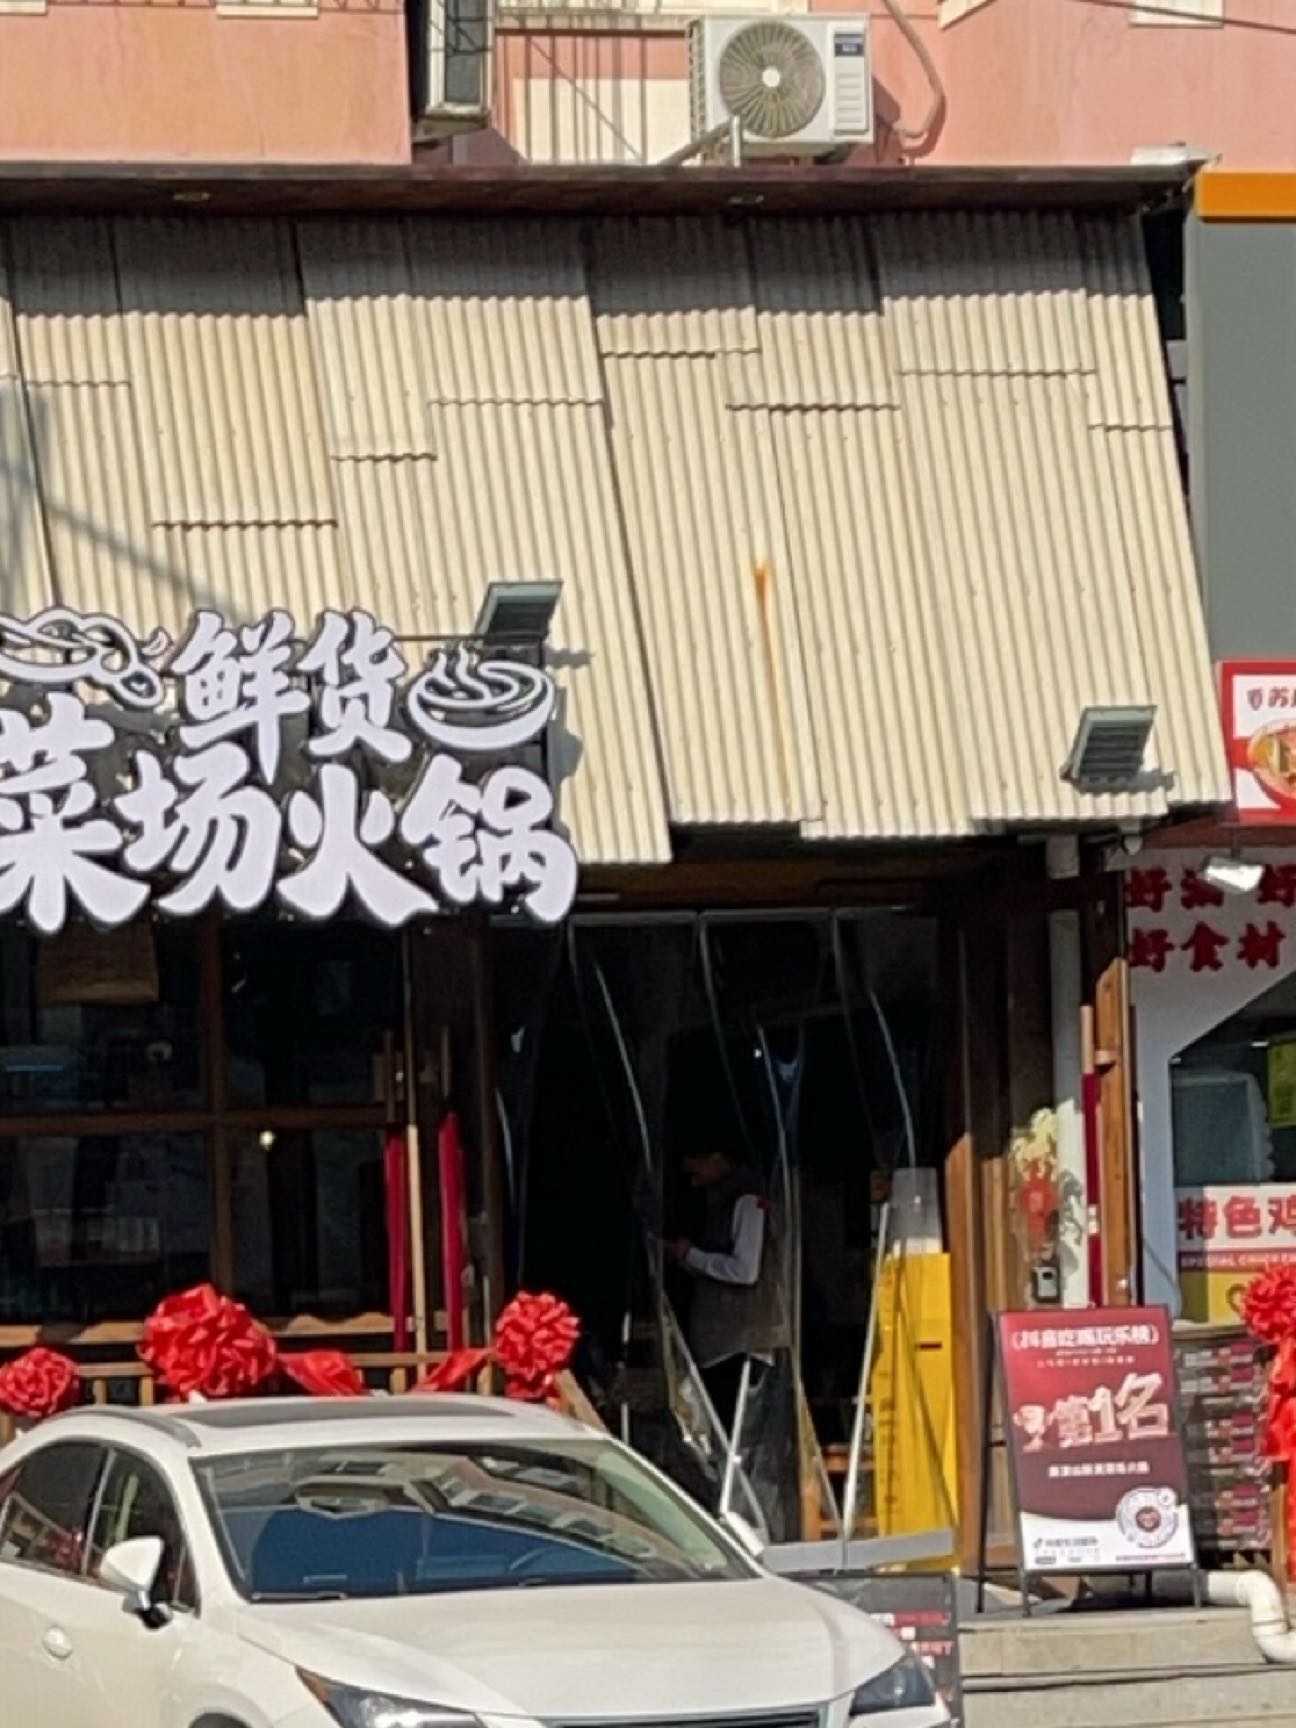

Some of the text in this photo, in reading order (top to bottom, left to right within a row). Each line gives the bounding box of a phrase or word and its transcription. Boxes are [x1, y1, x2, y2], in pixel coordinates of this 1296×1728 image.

[170, 607, 413, 785] 鲜货
[1128, 921, 1287, 973] 好食材
